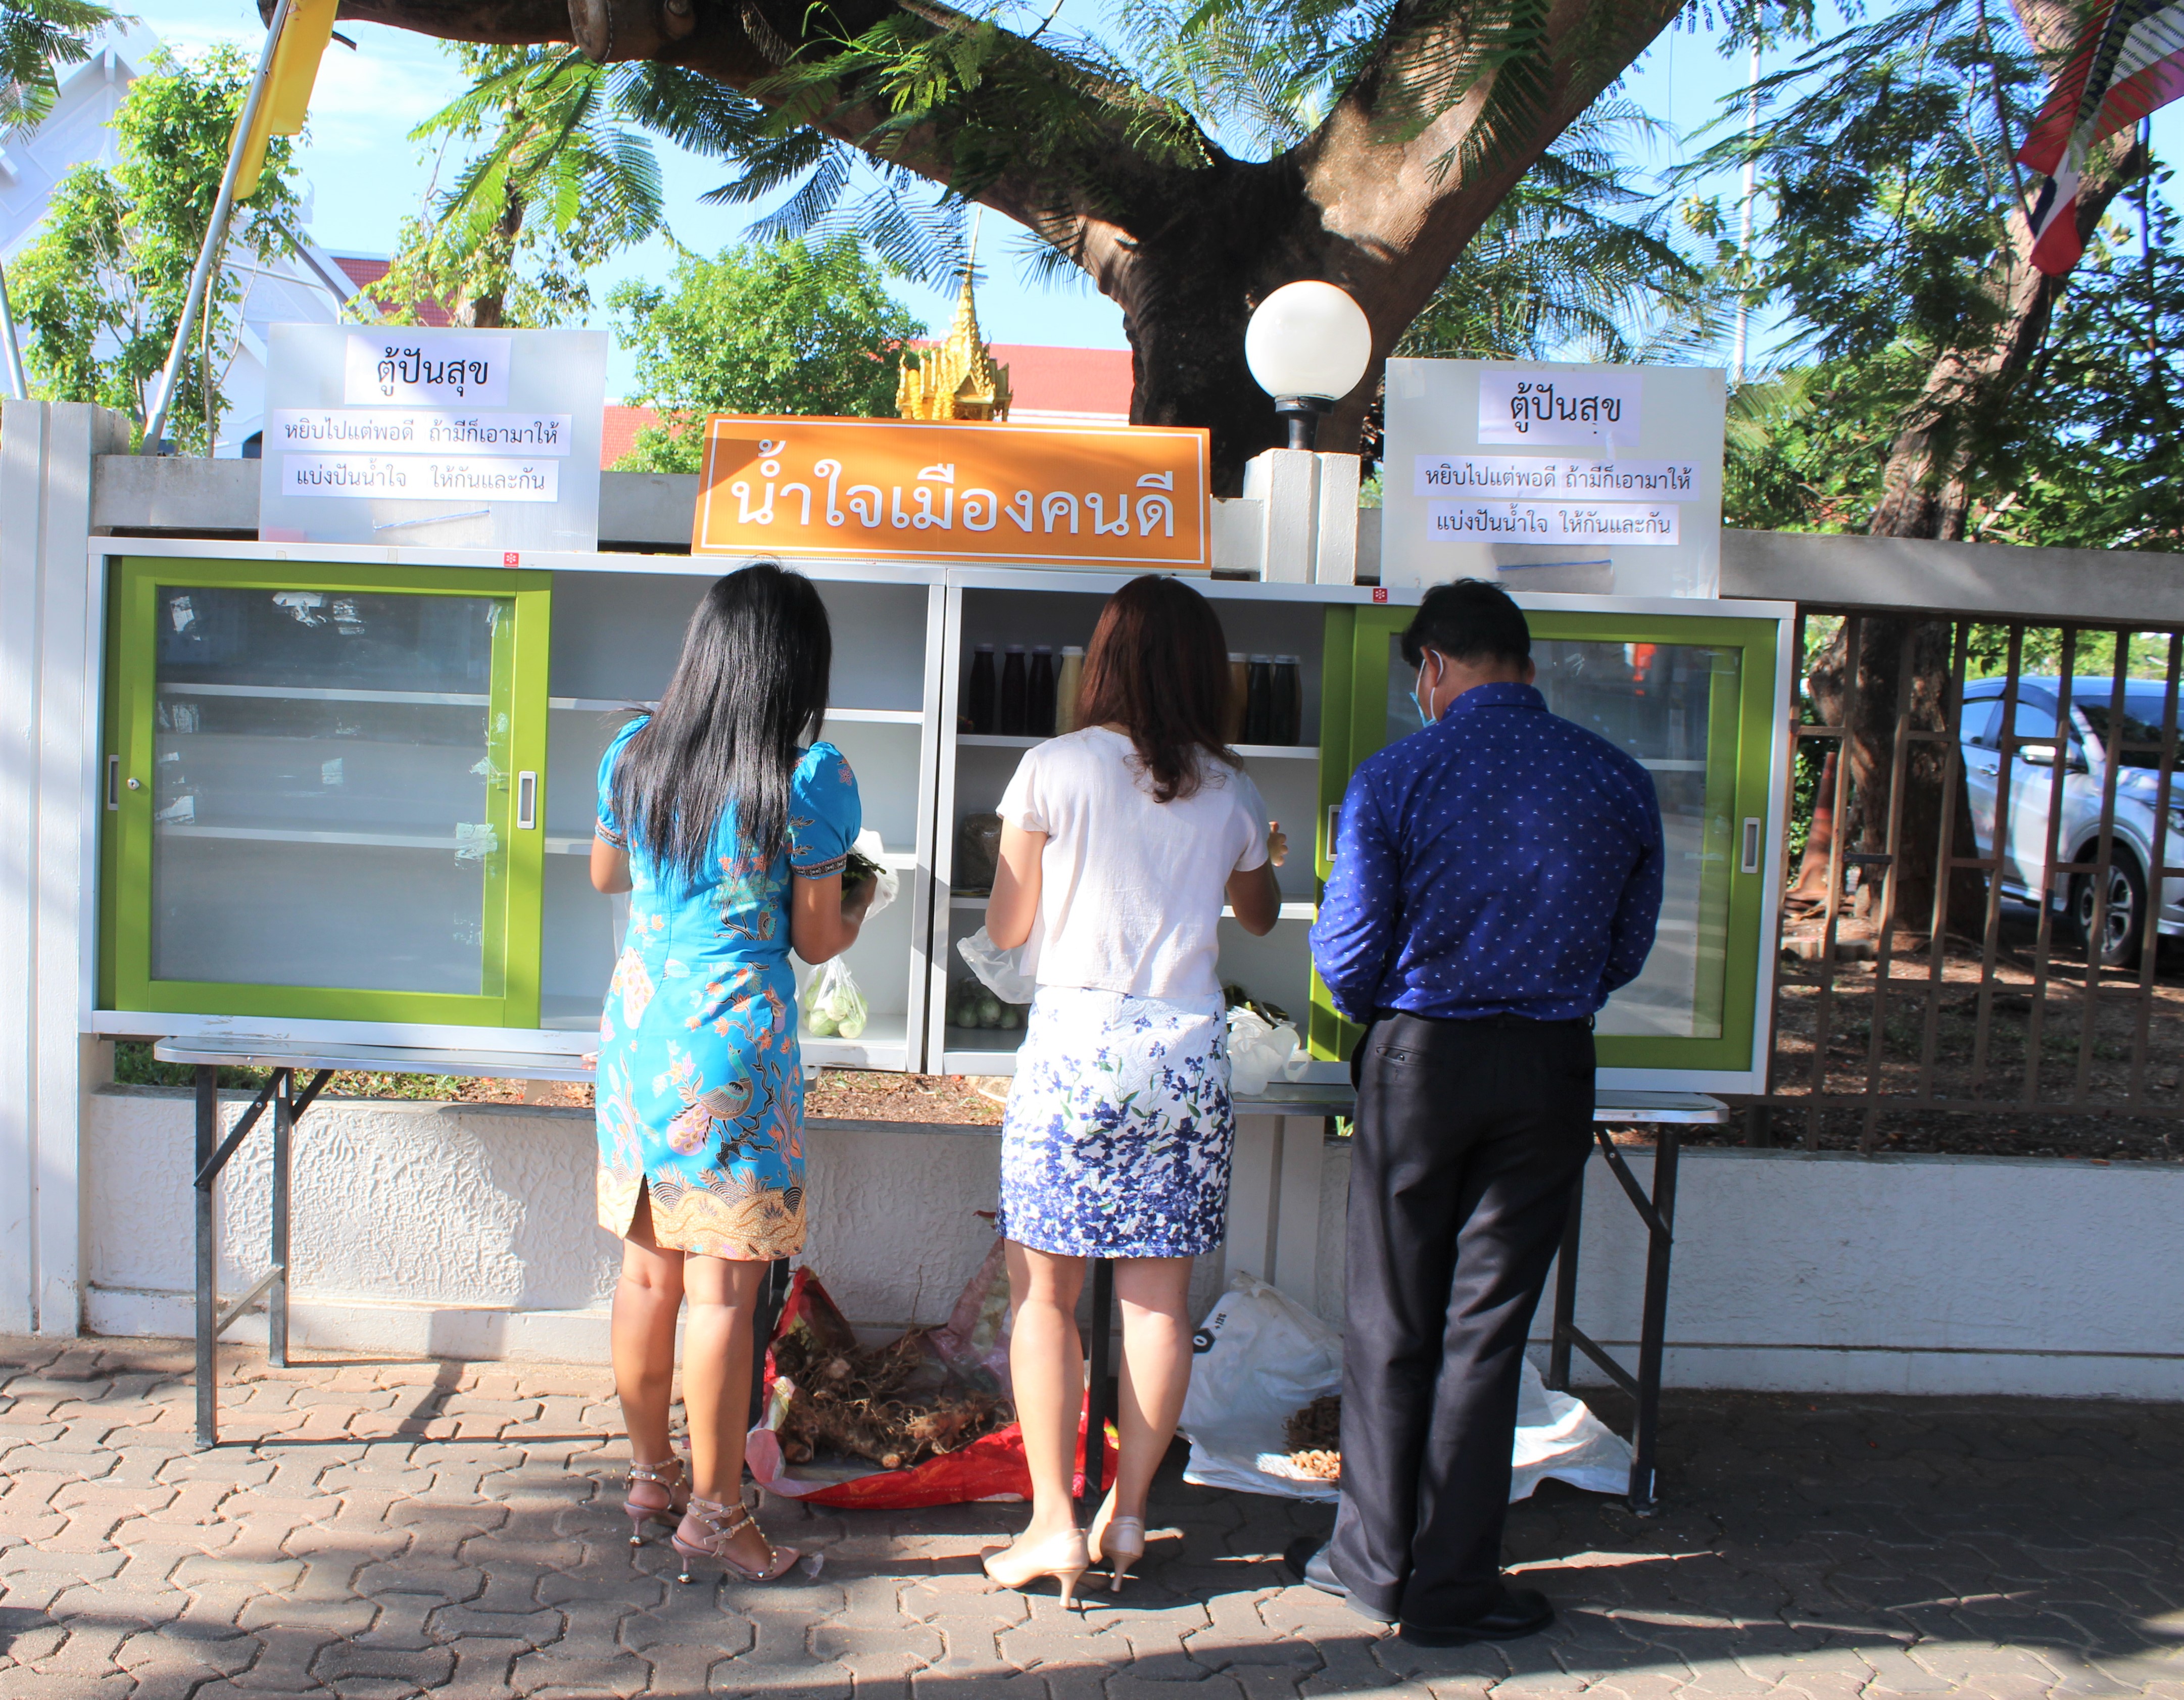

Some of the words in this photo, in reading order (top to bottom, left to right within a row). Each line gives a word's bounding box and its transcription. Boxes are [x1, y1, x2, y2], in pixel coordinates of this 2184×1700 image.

[377, 346, 489, 398] ตู้ปันสุข
[285, 417, 414, 442] หยิบไปแต่พอดี
[429, 418, 559, 445] ถ้ามีก็เอามาให้
[297, 457, 407, 488] แบ่งปันน้ำใจ
[430, 465, 545, 491] ให้กันและกัน
[731, 439, 1174, 538] น้ำใจเมืองคนดี
[1425, 462, 1556, 488] หยิบไปแต่พอดี
[1565, 465, 1691, 490] ถ้ามีก็เอามาให้
[1437, 502, 1548, 533] แบ่งปันน้ำใจ
[1559, 510, 1671, 535] ให้กันและกัน
